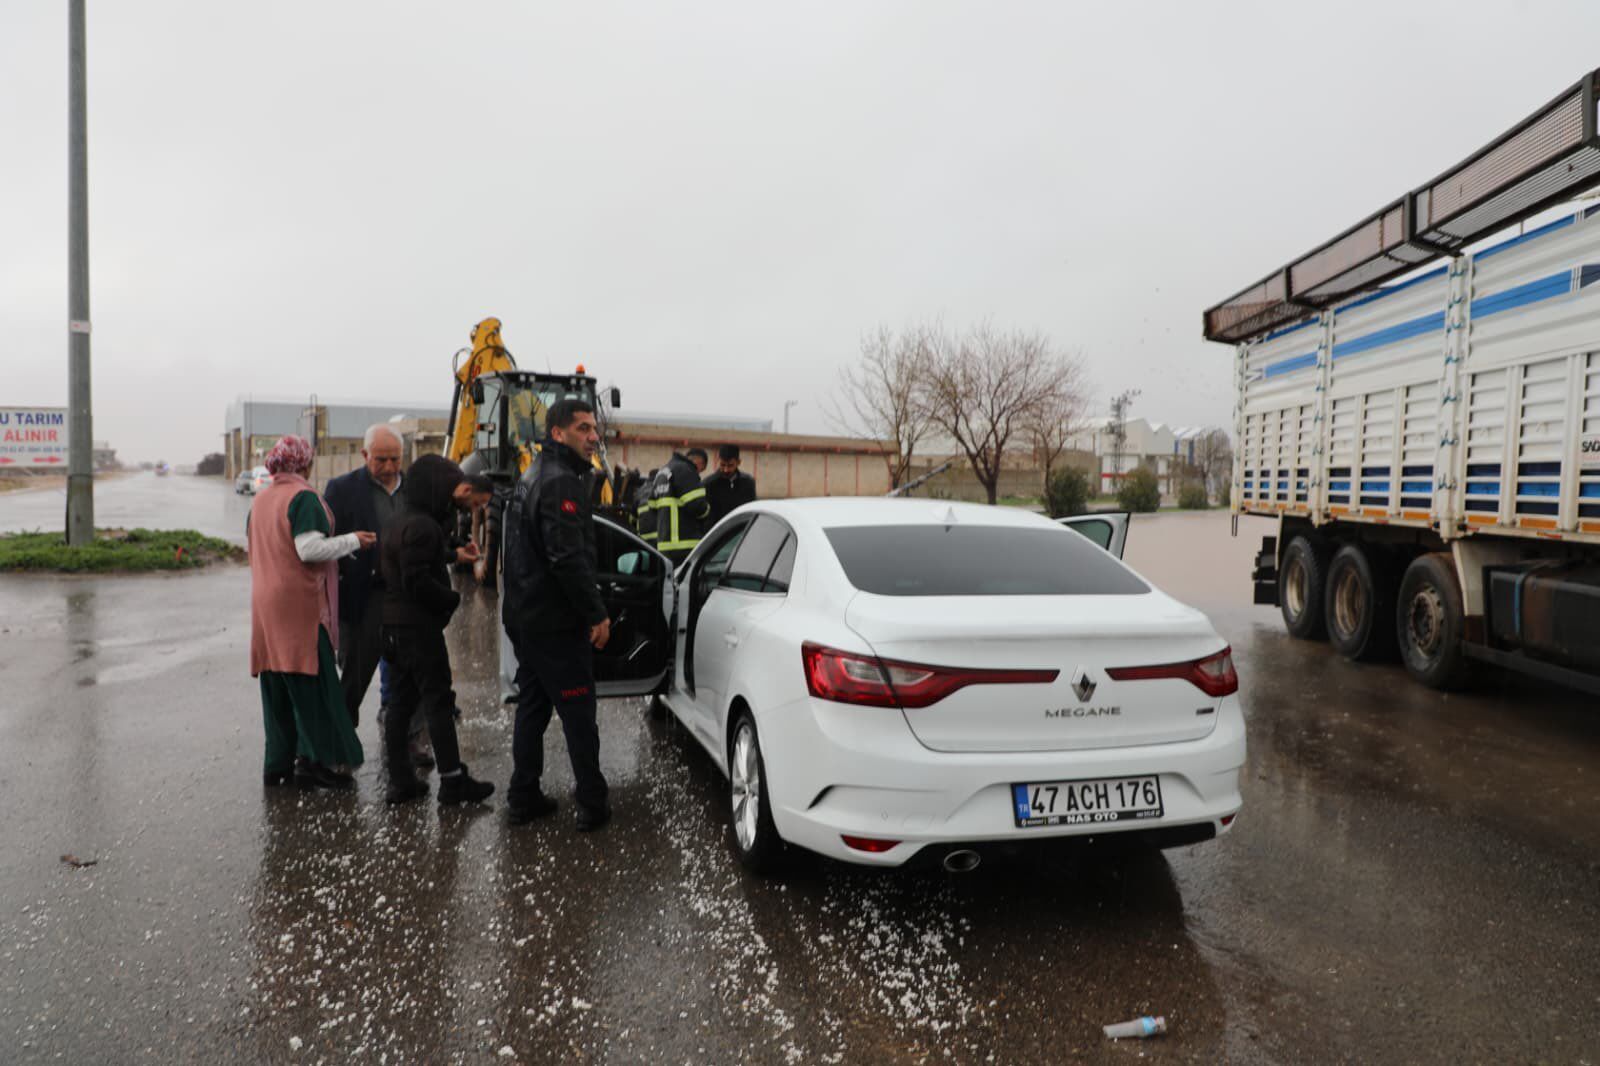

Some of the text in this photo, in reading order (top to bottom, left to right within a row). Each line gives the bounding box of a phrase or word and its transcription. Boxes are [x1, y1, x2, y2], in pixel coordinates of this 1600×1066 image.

[15, 413, 63, 425] TARIM
[4, 428, 58, 442] ALINIR
[1044, 707, 1121, 719] MEGANE
[1031, 780, 1156, 813] 47 ACH 176
[1094, 811, 1118, 822] OTO
